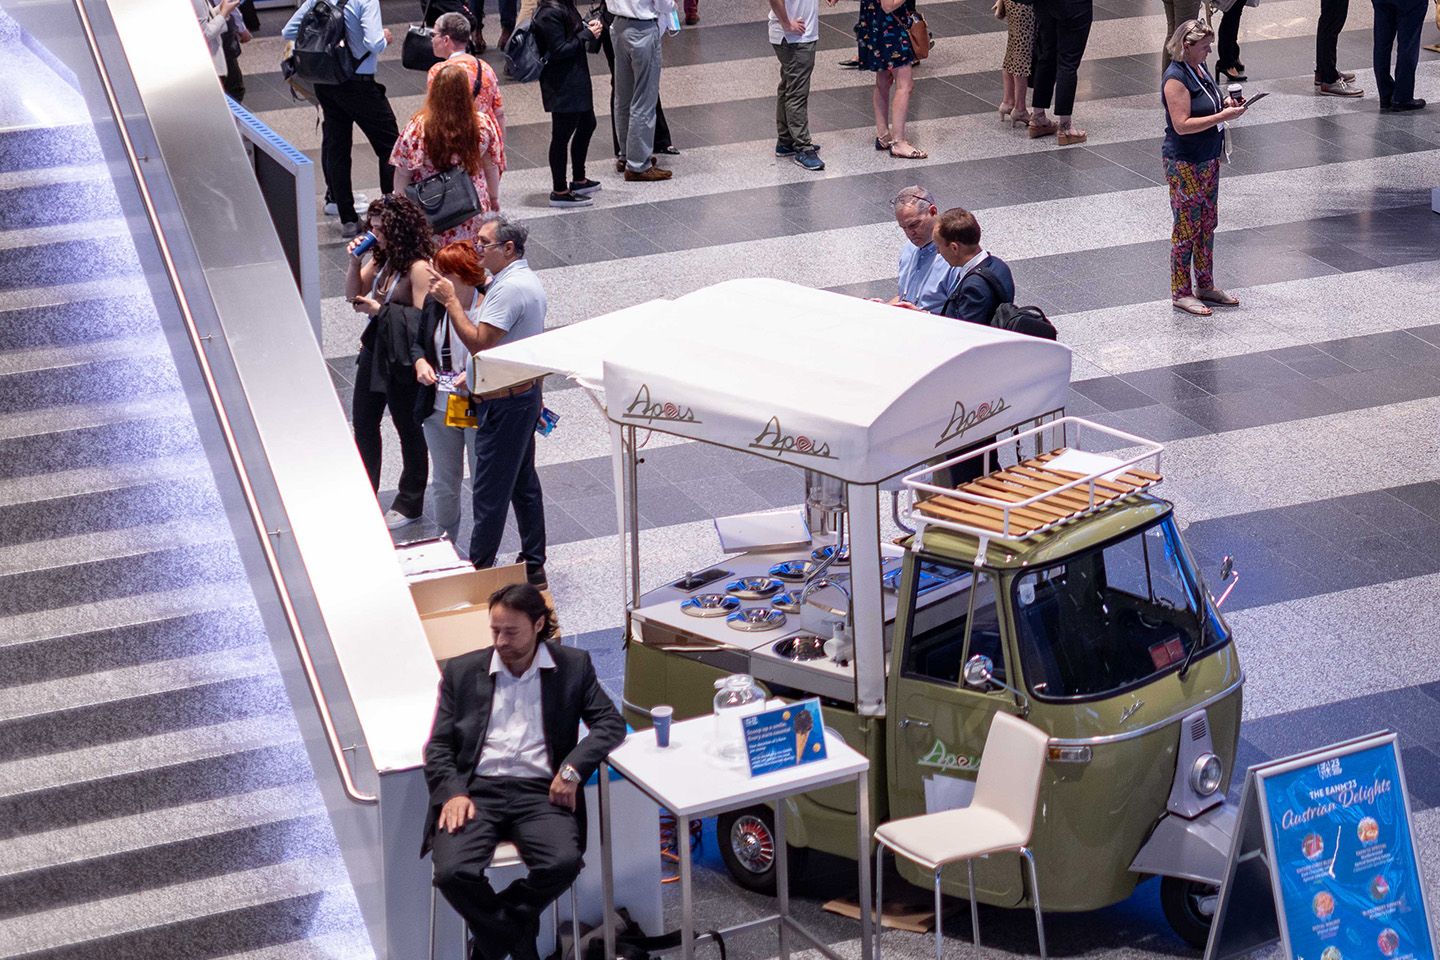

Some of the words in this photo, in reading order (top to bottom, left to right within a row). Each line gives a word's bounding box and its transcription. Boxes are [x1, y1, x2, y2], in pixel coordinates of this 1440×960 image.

[1281, 802, 1337, 830] Austrian
[1338, 779, 1392, 809] Delights
[1309, 788, 1325, 801] THE
